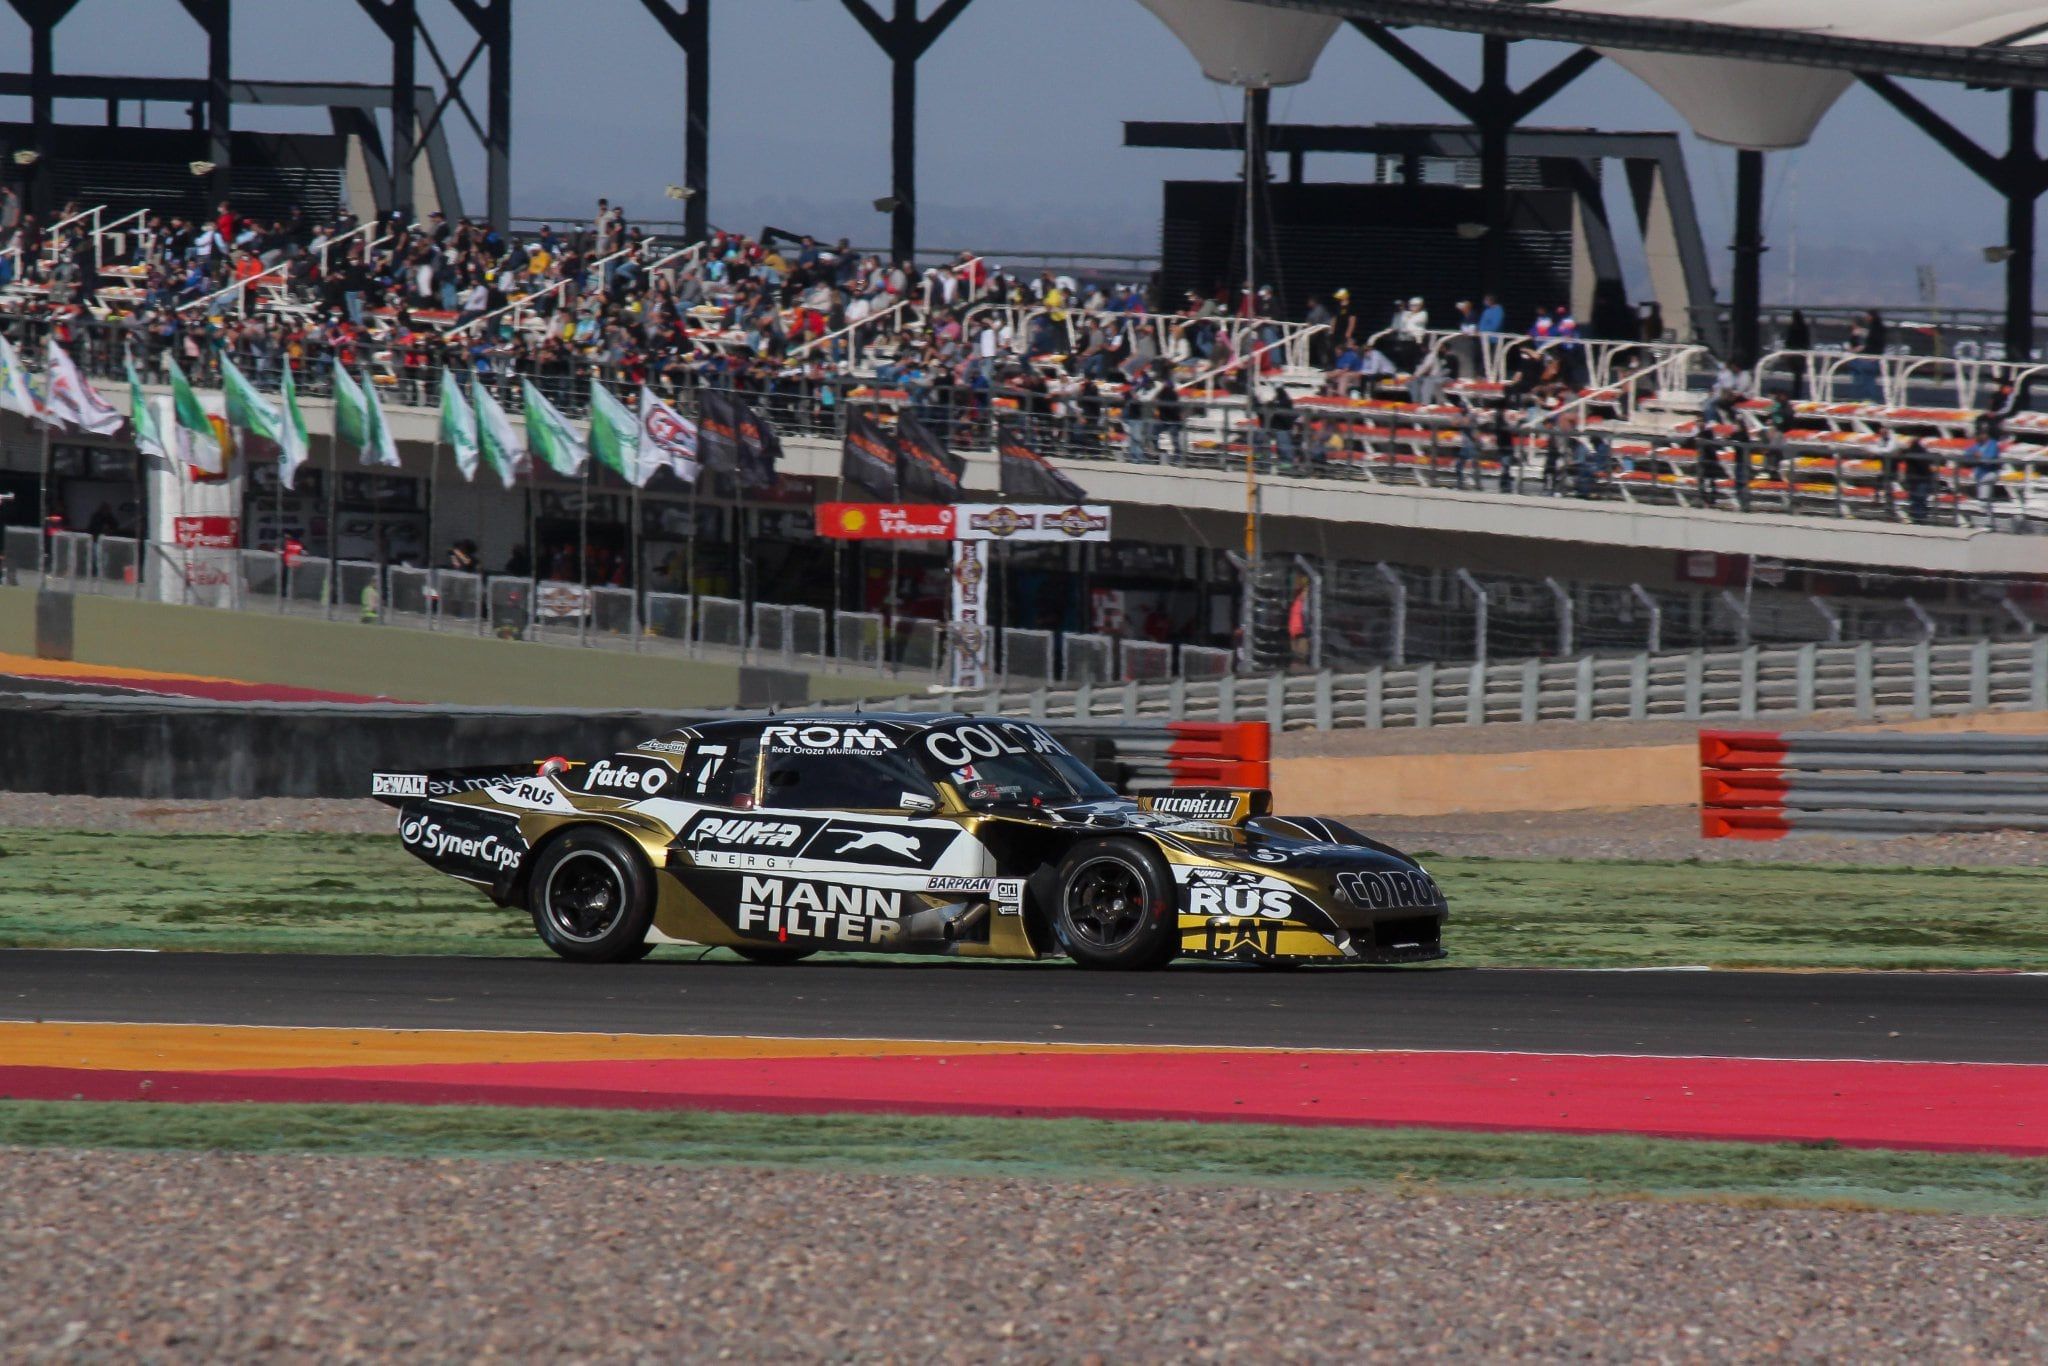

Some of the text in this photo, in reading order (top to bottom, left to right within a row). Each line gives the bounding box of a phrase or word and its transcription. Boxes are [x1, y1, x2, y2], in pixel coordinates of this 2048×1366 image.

[760, 726, 897, 749] ROM
[771, 745, 791, 754] Red
[793, 746, 824, 755] Oroza
[927, 724, 1072, 766] COLCA
[697, 745, 727, 793] 7
[518, 783, 555, 805] RUS
[1153, 797, 1234, 813] CICCARELLI
[423, 824, 521, 871] SynerCrps
[688, 817, 801, 848] PUMA
[741, 876, 901, 918] MANN
[928, 878, 990, 890] BARPRAN
[999, 885, 1017, 897] art
[1190, 886, 1293, 918] RUS
[739, 903, 901, 944] FILTER
[1206, 916, 1284, 954] CAT
